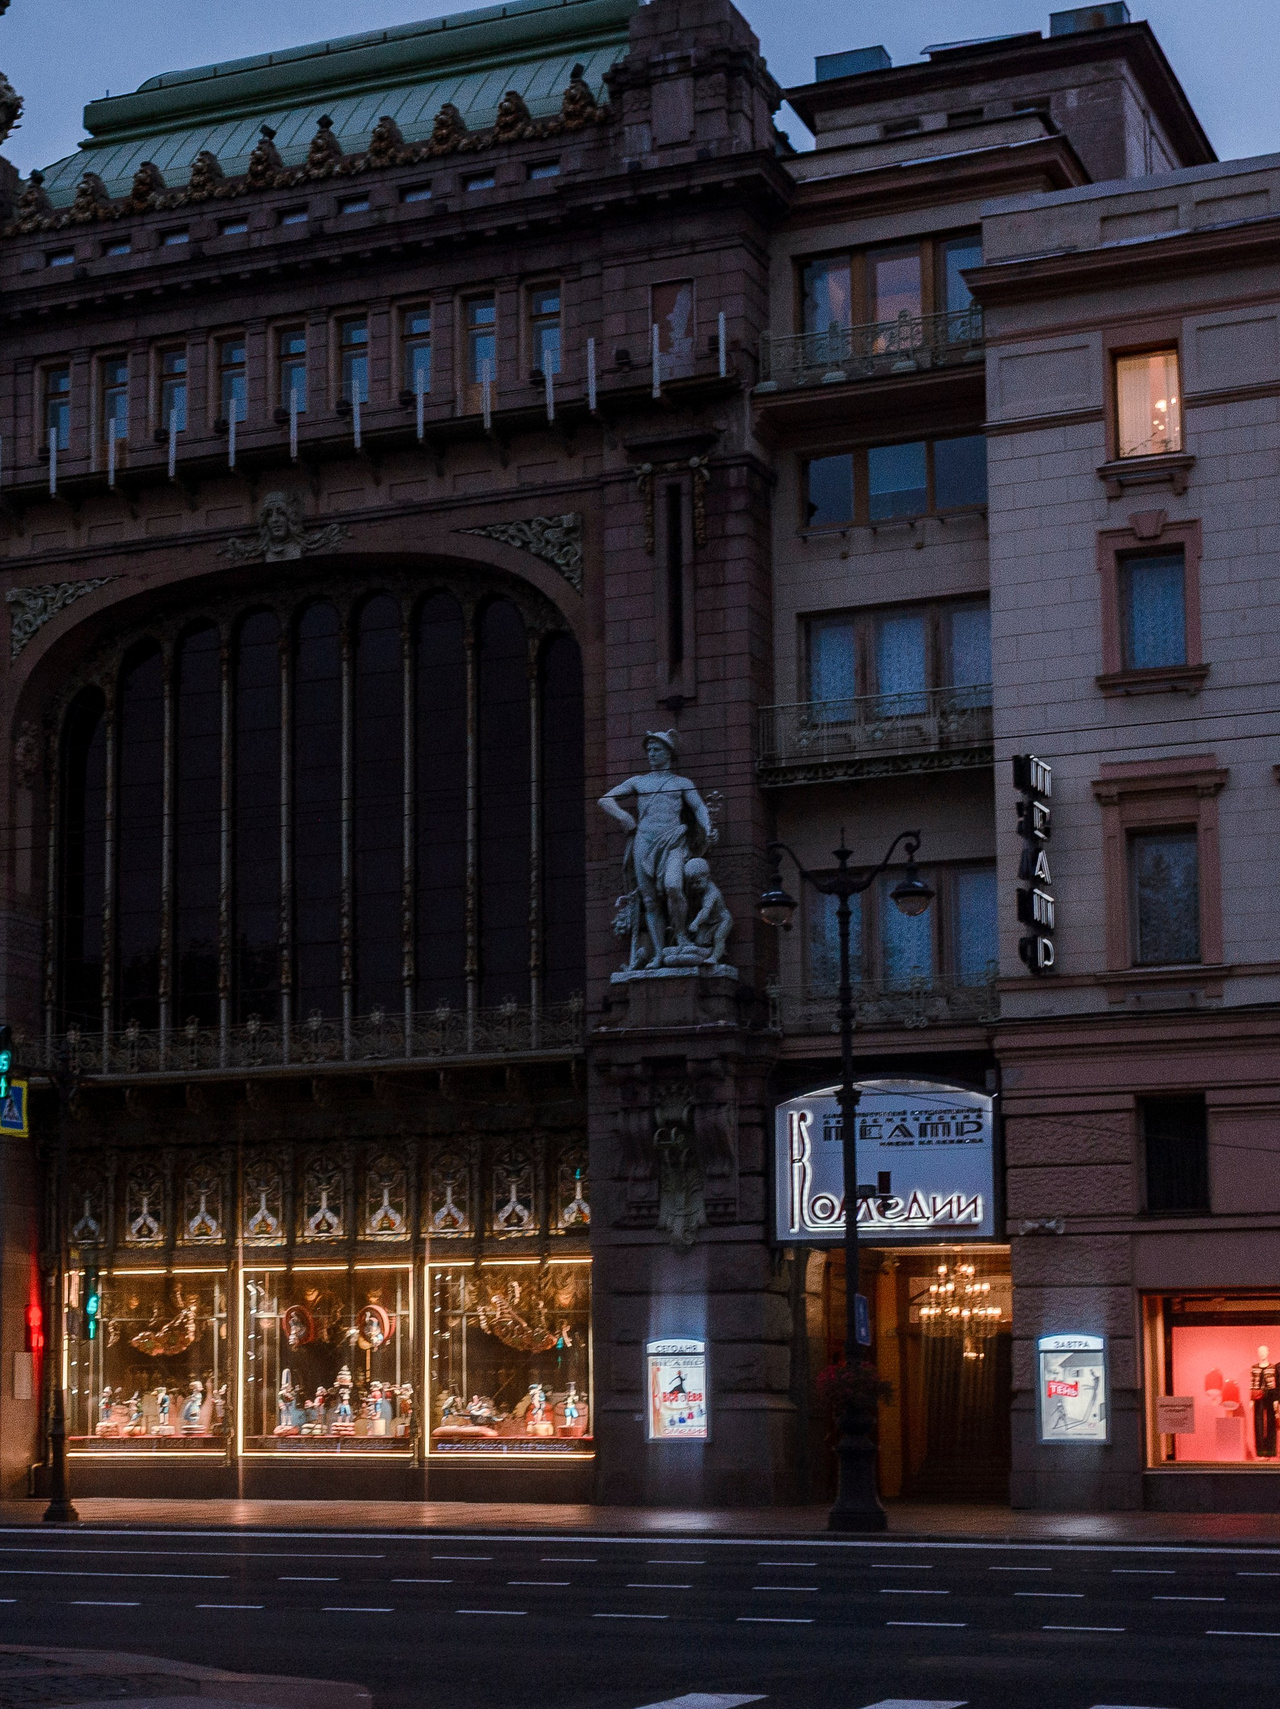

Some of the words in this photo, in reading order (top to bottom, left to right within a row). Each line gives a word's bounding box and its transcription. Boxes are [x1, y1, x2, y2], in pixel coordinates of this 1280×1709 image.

[655, 1344, 698, 1353] СЕГОДНЯ
[1053, 1340, 1090, 1349] ЗАВТРА
[1049, 1384, 1078, 1397] ТЕНЬ
